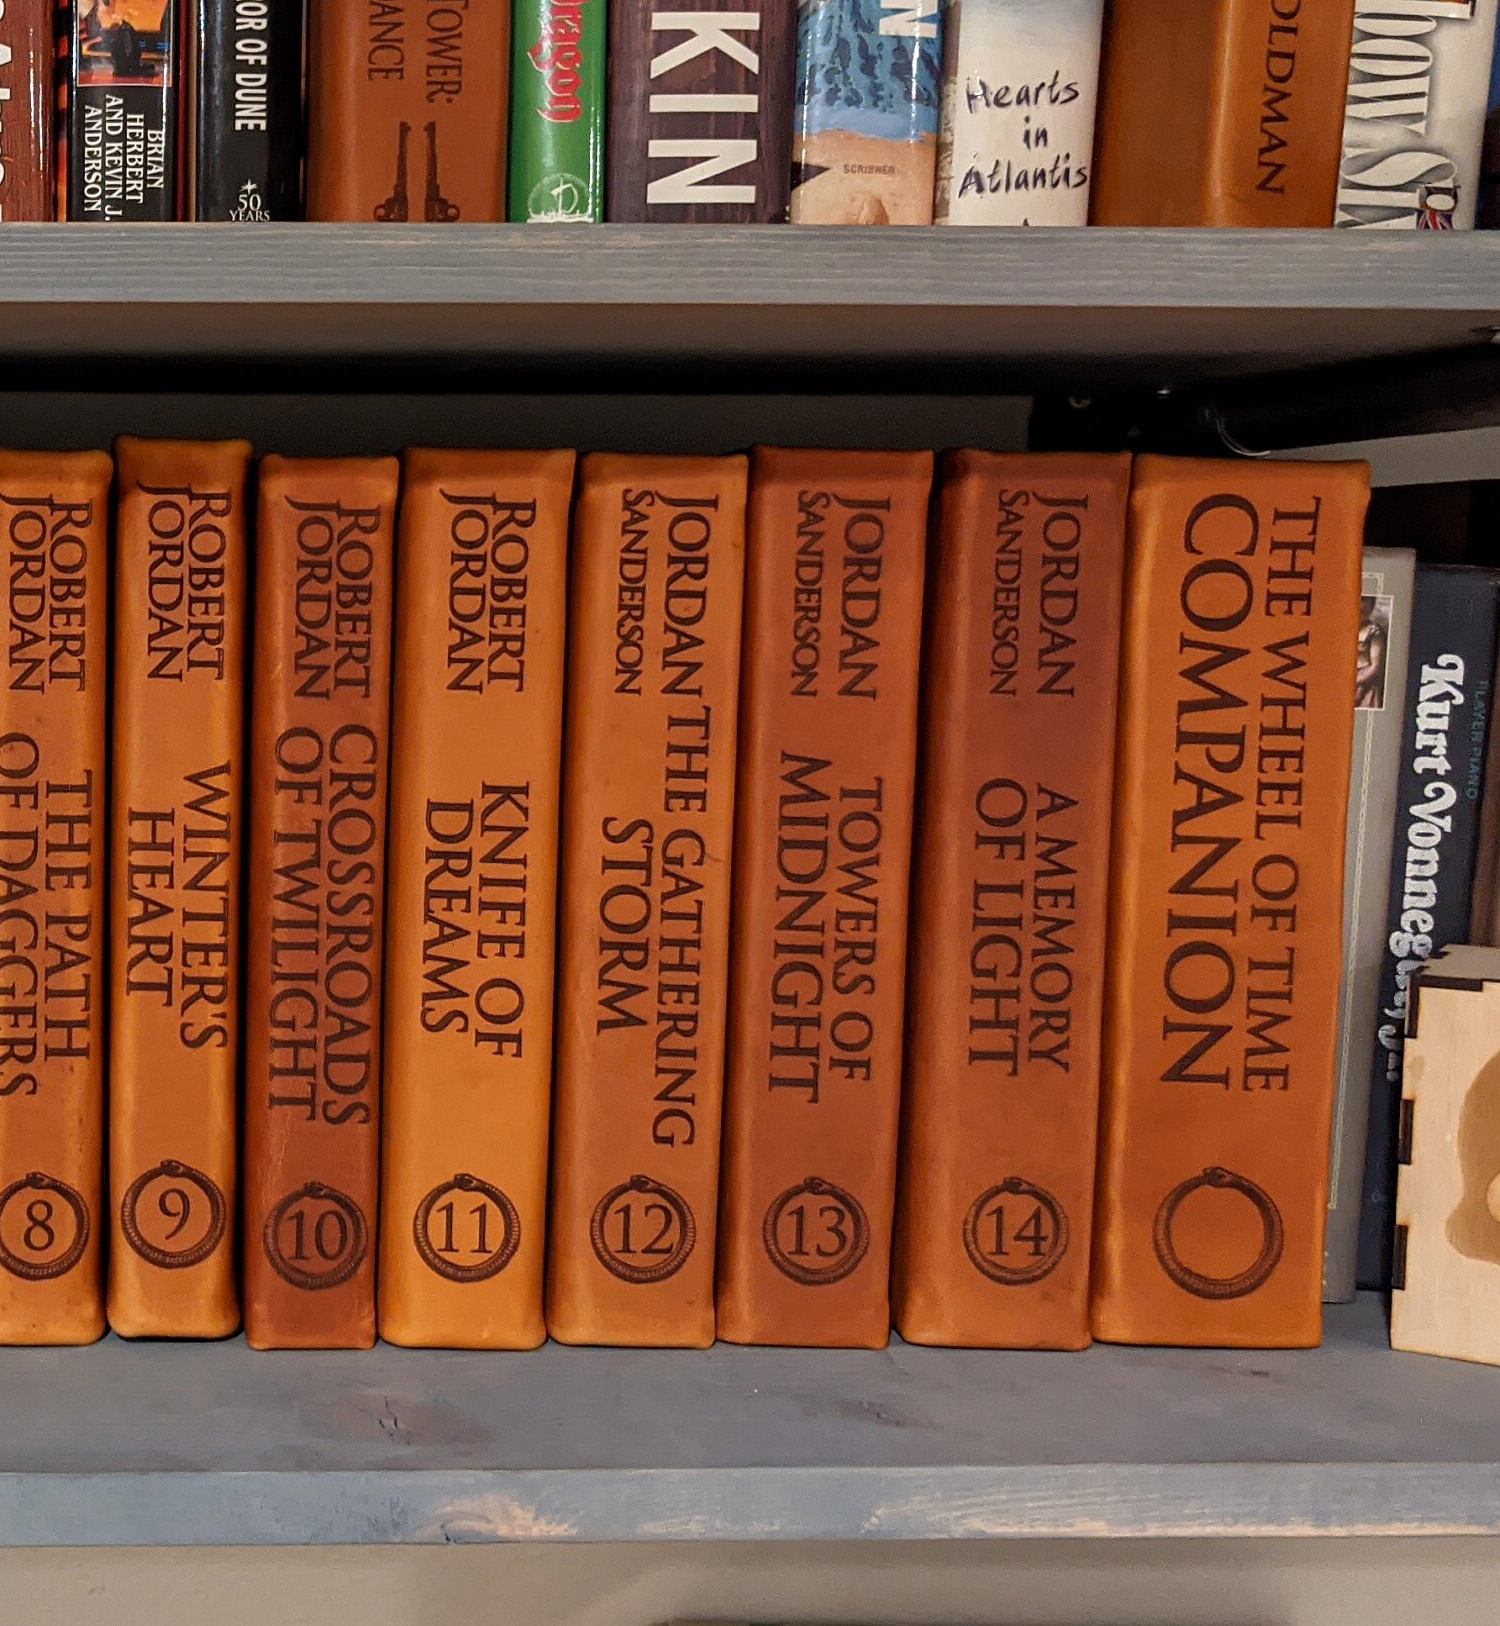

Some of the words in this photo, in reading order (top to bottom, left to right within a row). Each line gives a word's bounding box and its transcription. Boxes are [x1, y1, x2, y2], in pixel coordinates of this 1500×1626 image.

[235, 0, 268, 31] OR
[235, 39, 268, 65] OF
[367, 0, 405, 81] ANCE
[105, 94, 123, 136] AND
[234, 73, 267, 131] DUNE
[647, 12, 760, 203] KIN
[965, 70, 1080, 113] Hearts
[1022, 116, 1048, 149] in
[1255, 0, 1300, 195] OLDMAN
[84, 105, 102, 212] ANDERSON
[104, 205, 122, 221] J.
[105, 142, 123, 199] KEVIN
[126, 113, 145, 203] HERBERT
[146, 129, 164, 189] BRIAN
[229, 210, 270, 221] YEARS
[237, 194, 261, 211] 50
[843, 164, 895, 175] SCRIBNER
[958, 153, 1089, 198] Atlantis
[46, 493, 93, 693] ROBERT
[137, 480, 191, 683] JORDAN
[186, 484, 232, 681] ROBERT
[284, 495, 336, 700] JORDAN
[333, 498, 380, 698] ROBERT
[439, 488, 495, 694] JORDAN
[487, 491, 537, 693] ROBERT
[614, 488, 654, 697] SANDERSON
[654, 490, 720, 698] JORDAN
[791, 489, 831, 697] SANDERSON
[831, 491, 891, 701] JORDAN
[989, 488, 1030, 698] SANDERSON
[1032, 490, 1089, 698] JORDAN
[1263, 497, 1322, 618] THE
[274, 727, 323, 806] OF
[663, 705, 711, 814] THE
[1254, 631, 1310, 840] WHEEL
[1413, 653, 1465, 776] Kurt
[1467, 680, 1488, 744] PLAYER
[45, 770, 92, 890] THE
[975, 777, 1028, 859] OF
[1036, 782, 1079, 819] A
[1160, 493, 1260, 1091] COMPANION
[1464, 749, 1483, 800] PIANO
[126, 807, 175, 1008] HEART
[179, 759, 232, 1050] WINTER'S
[321, 723, 378, 1126] CROSSROADS
[420, 799, 475, 1034] DREAMS
[476, 780, 531, 960] KNIFE
[596, 816, 654, 1038] STORM
[767, 750, 832, 1104] MIDNIGHT
[831, 776, 883, 999] TOWERS
[1249, 854, 1300, 933] OF
[44, 911, 91, 1061] PATH
[268, 818, 321, 1122] TWILIGHT
[652, 828, 706, 1149] GATHERING
[968, 879, 1025, 1077] LIGHT
[1028, 833, 1078, 1073] MEMORY
[474, 977, 526, 1059] OF
[828, 1011, 874, 1082] OF
[1241, 946, 1296, 1093] TIME
[23, 1199, 55, 1251] 8
[157, 1188, 190, 1239] 9
[288, 1209, 348, 1261] 10
[436, 1202, 490, 1255] 11
[614, 1202, 676, 1255] 12
[787, 1204, 848, 1256] 13
[984, 1204, 1049, 1257] 14
